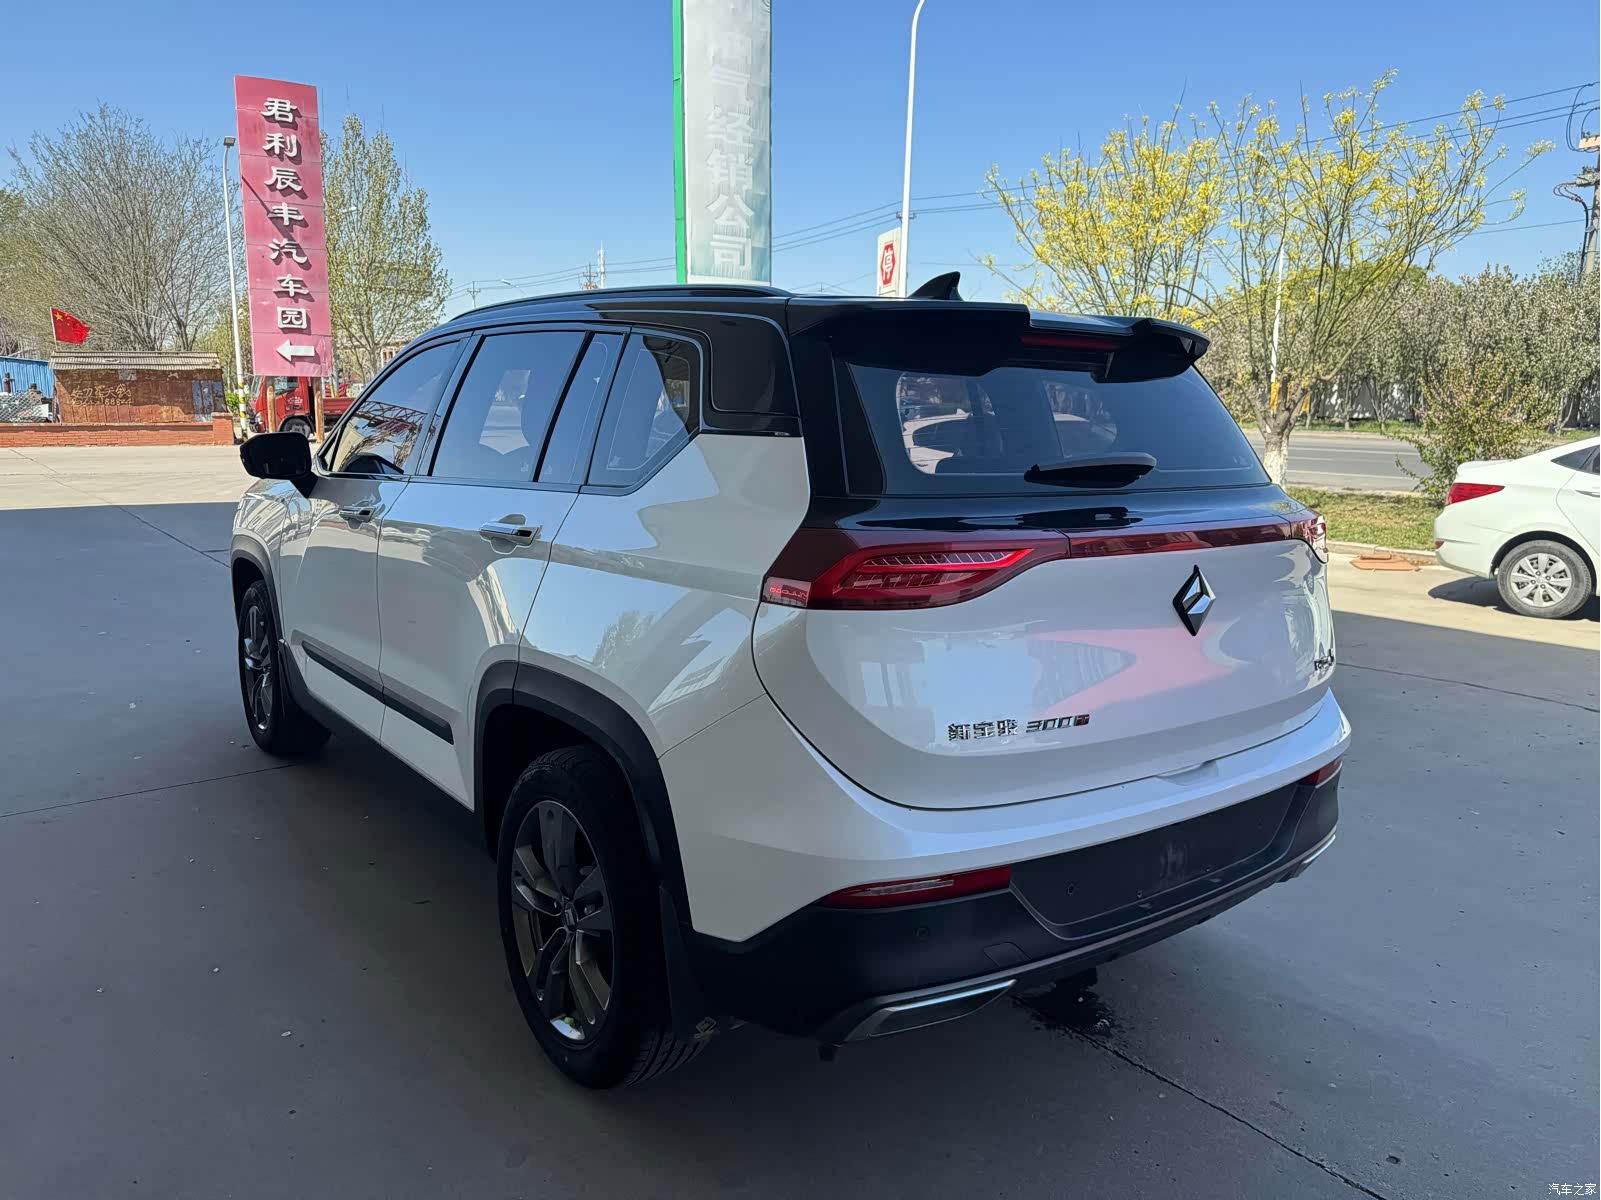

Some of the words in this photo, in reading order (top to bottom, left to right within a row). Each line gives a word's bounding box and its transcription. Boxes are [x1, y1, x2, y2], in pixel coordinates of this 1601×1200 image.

[260, 97, 309, 329] 君利辰丰汽车园
[881, 246, 895, 281] 停
[948, 719, 1018, 741] 新宝骏
